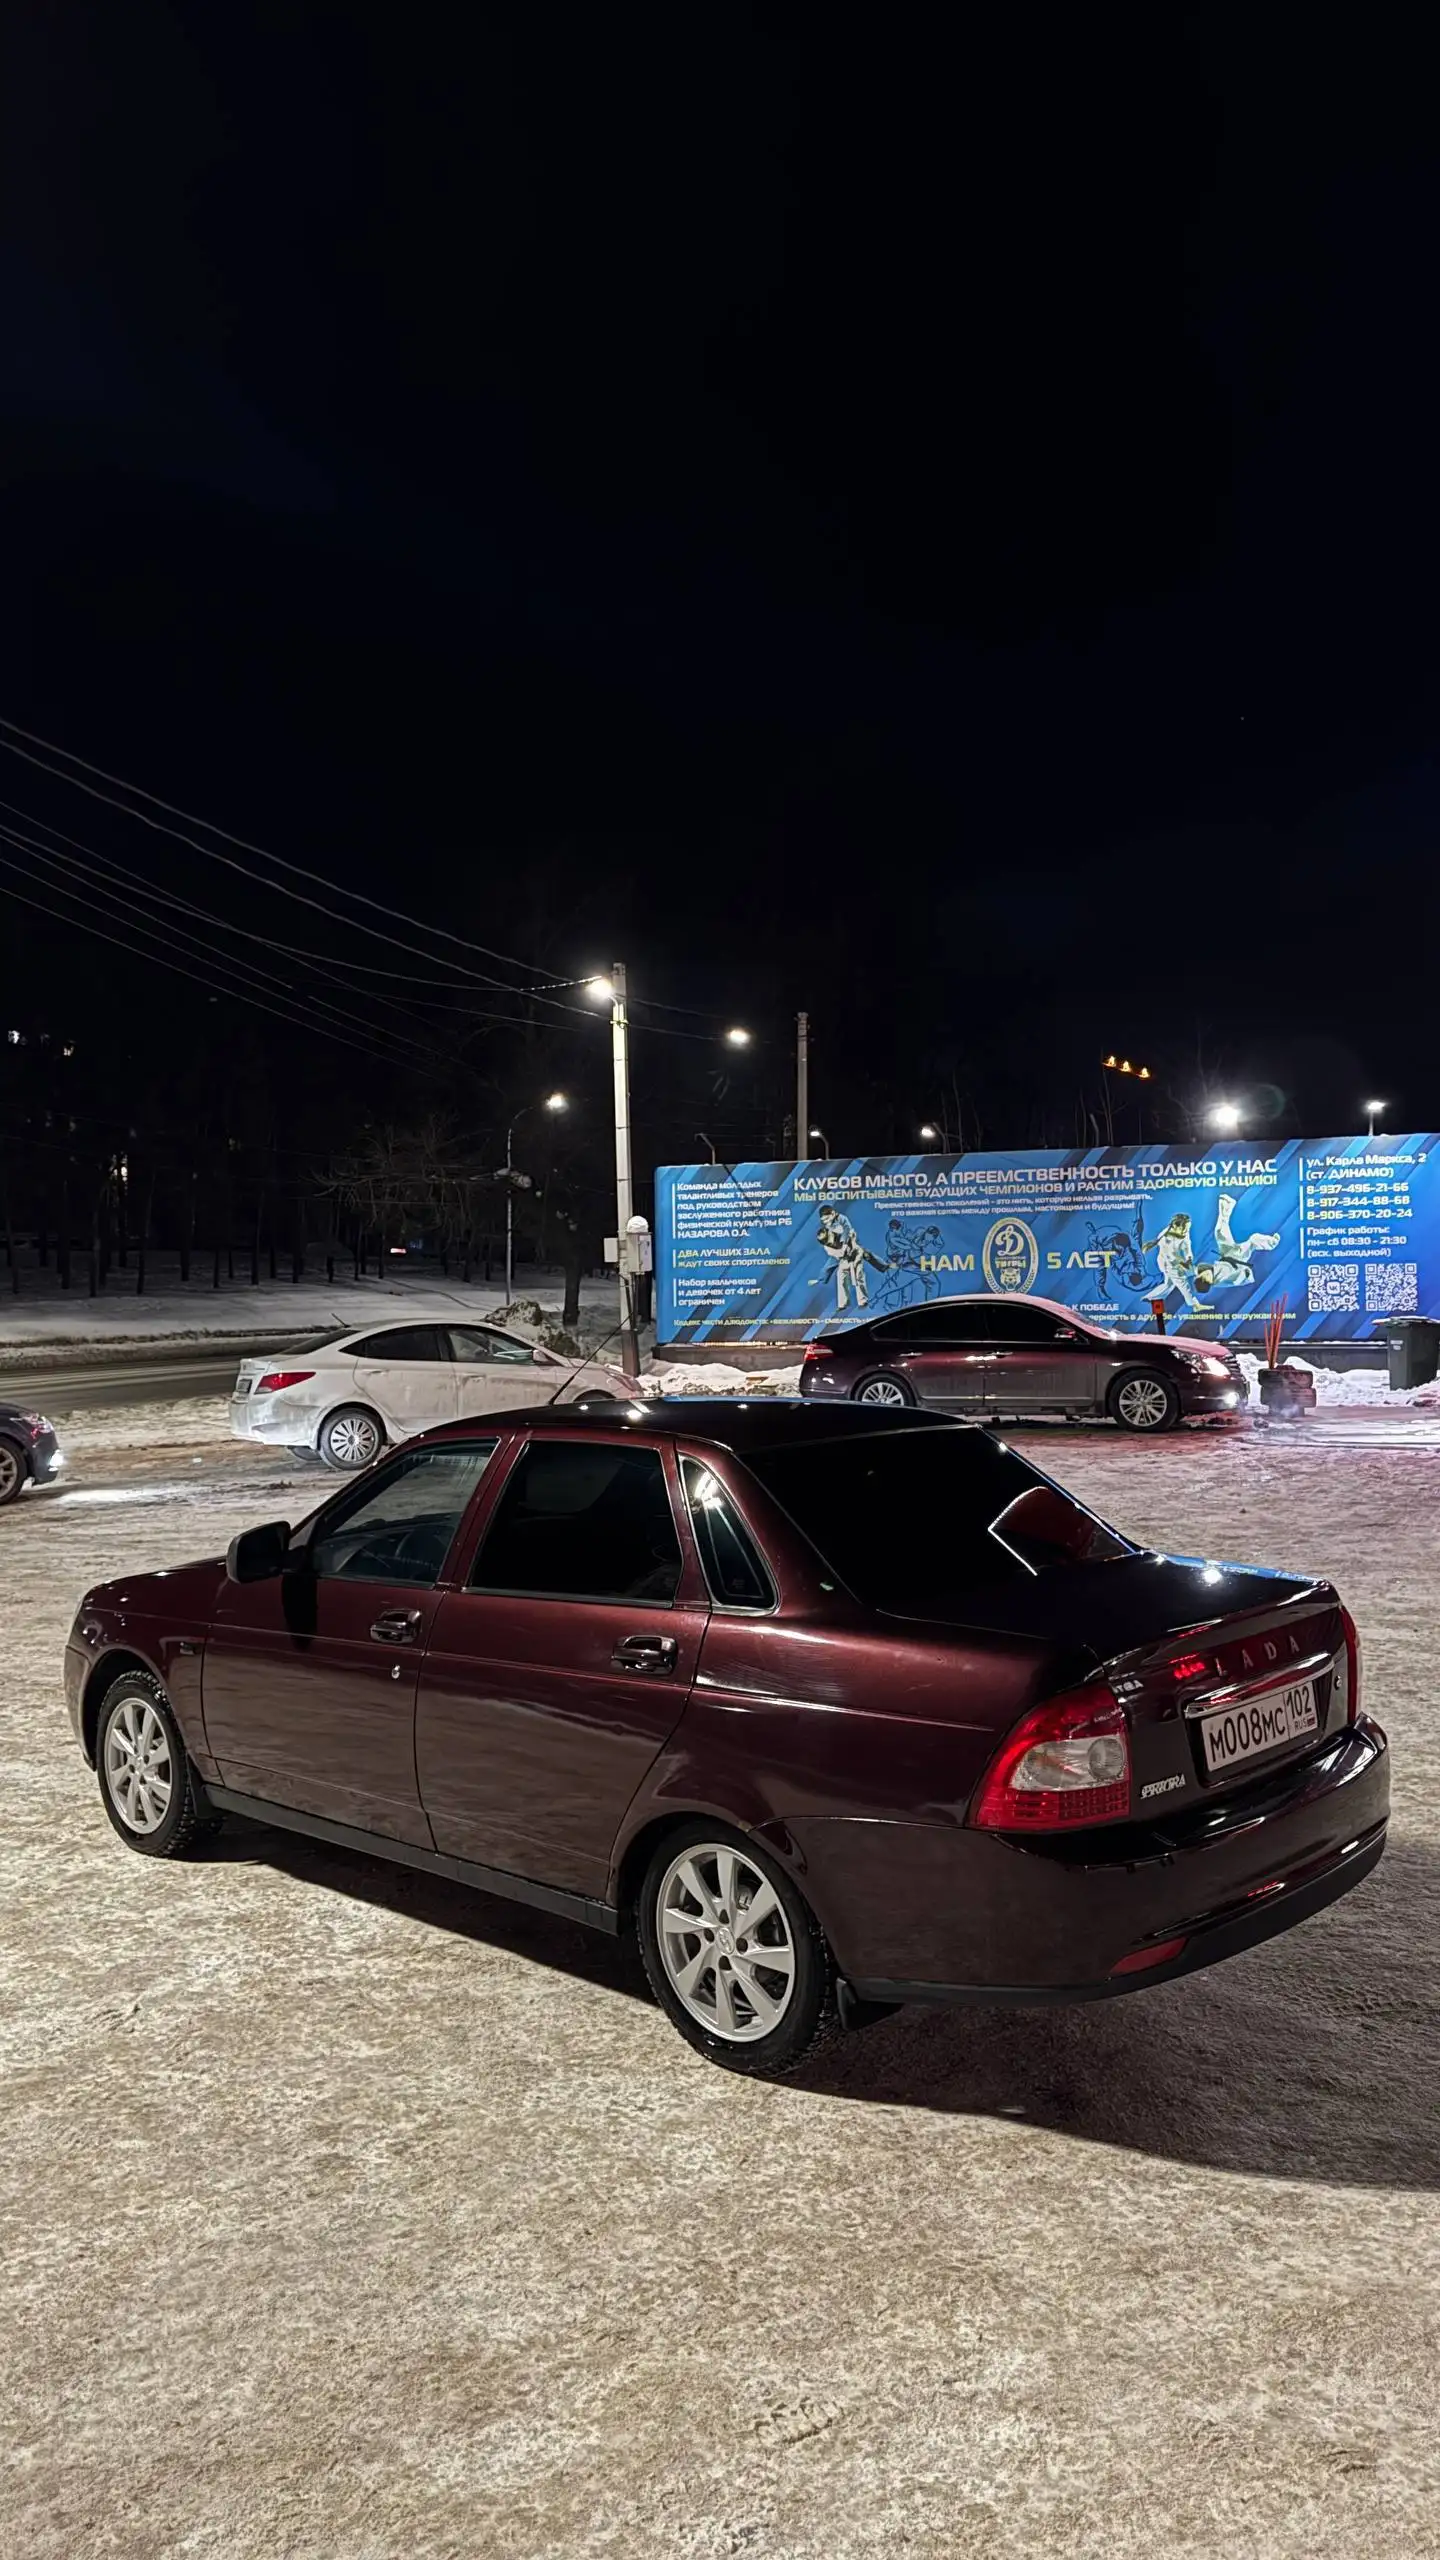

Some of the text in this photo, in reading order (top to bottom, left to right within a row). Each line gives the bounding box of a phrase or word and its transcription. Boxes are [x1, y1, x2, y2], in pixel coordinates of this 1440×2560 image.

[1325, 1156, 1364, 1167] Карла
[1418, 1153, 1428, 1163] 2
[794, 1158, 1278, 1191] КЛУБОВ МНОГО, А ПРЕЕМСТВЕННОСТЬ ТОЛЬКО У НАС
[1328, 1167, 1394, 1180] ДИНАМО)
[677, 1183, 718, 1191] Команда
[794, 1173, 1278, 1202] МЫ ВОСПИТЫВАЕМ БУДУЩИХ ЧЕМПИОНОВ И РАСТИМ ЗДОРОВУЮ НАЦИЮ!
[677, 1202, 696, 1211] под
[677, 1229, 731, 1239] НАЗАРОВА
[1306, 1227, 1347, 1237] График
[1379, 1235, 1408, 1244] 21:30
[677, 1247, 771, 1258] ДВА ЛУЧШИХ ЗАЛА
[920, 1250, 1116, 1272] НАМ 5 ЛЕТ
[678, 1278, 707, 1287] Набор
[736, 1286, 745, 1295] 4
[1080, 1303, 1120, 1312] ПОБЕДЕ
[1214, 1635, 1301, 1678] LADA
[1286, 1685, 1312, 1720] 102
[1294, 1718, 1308, 1732] RUS
